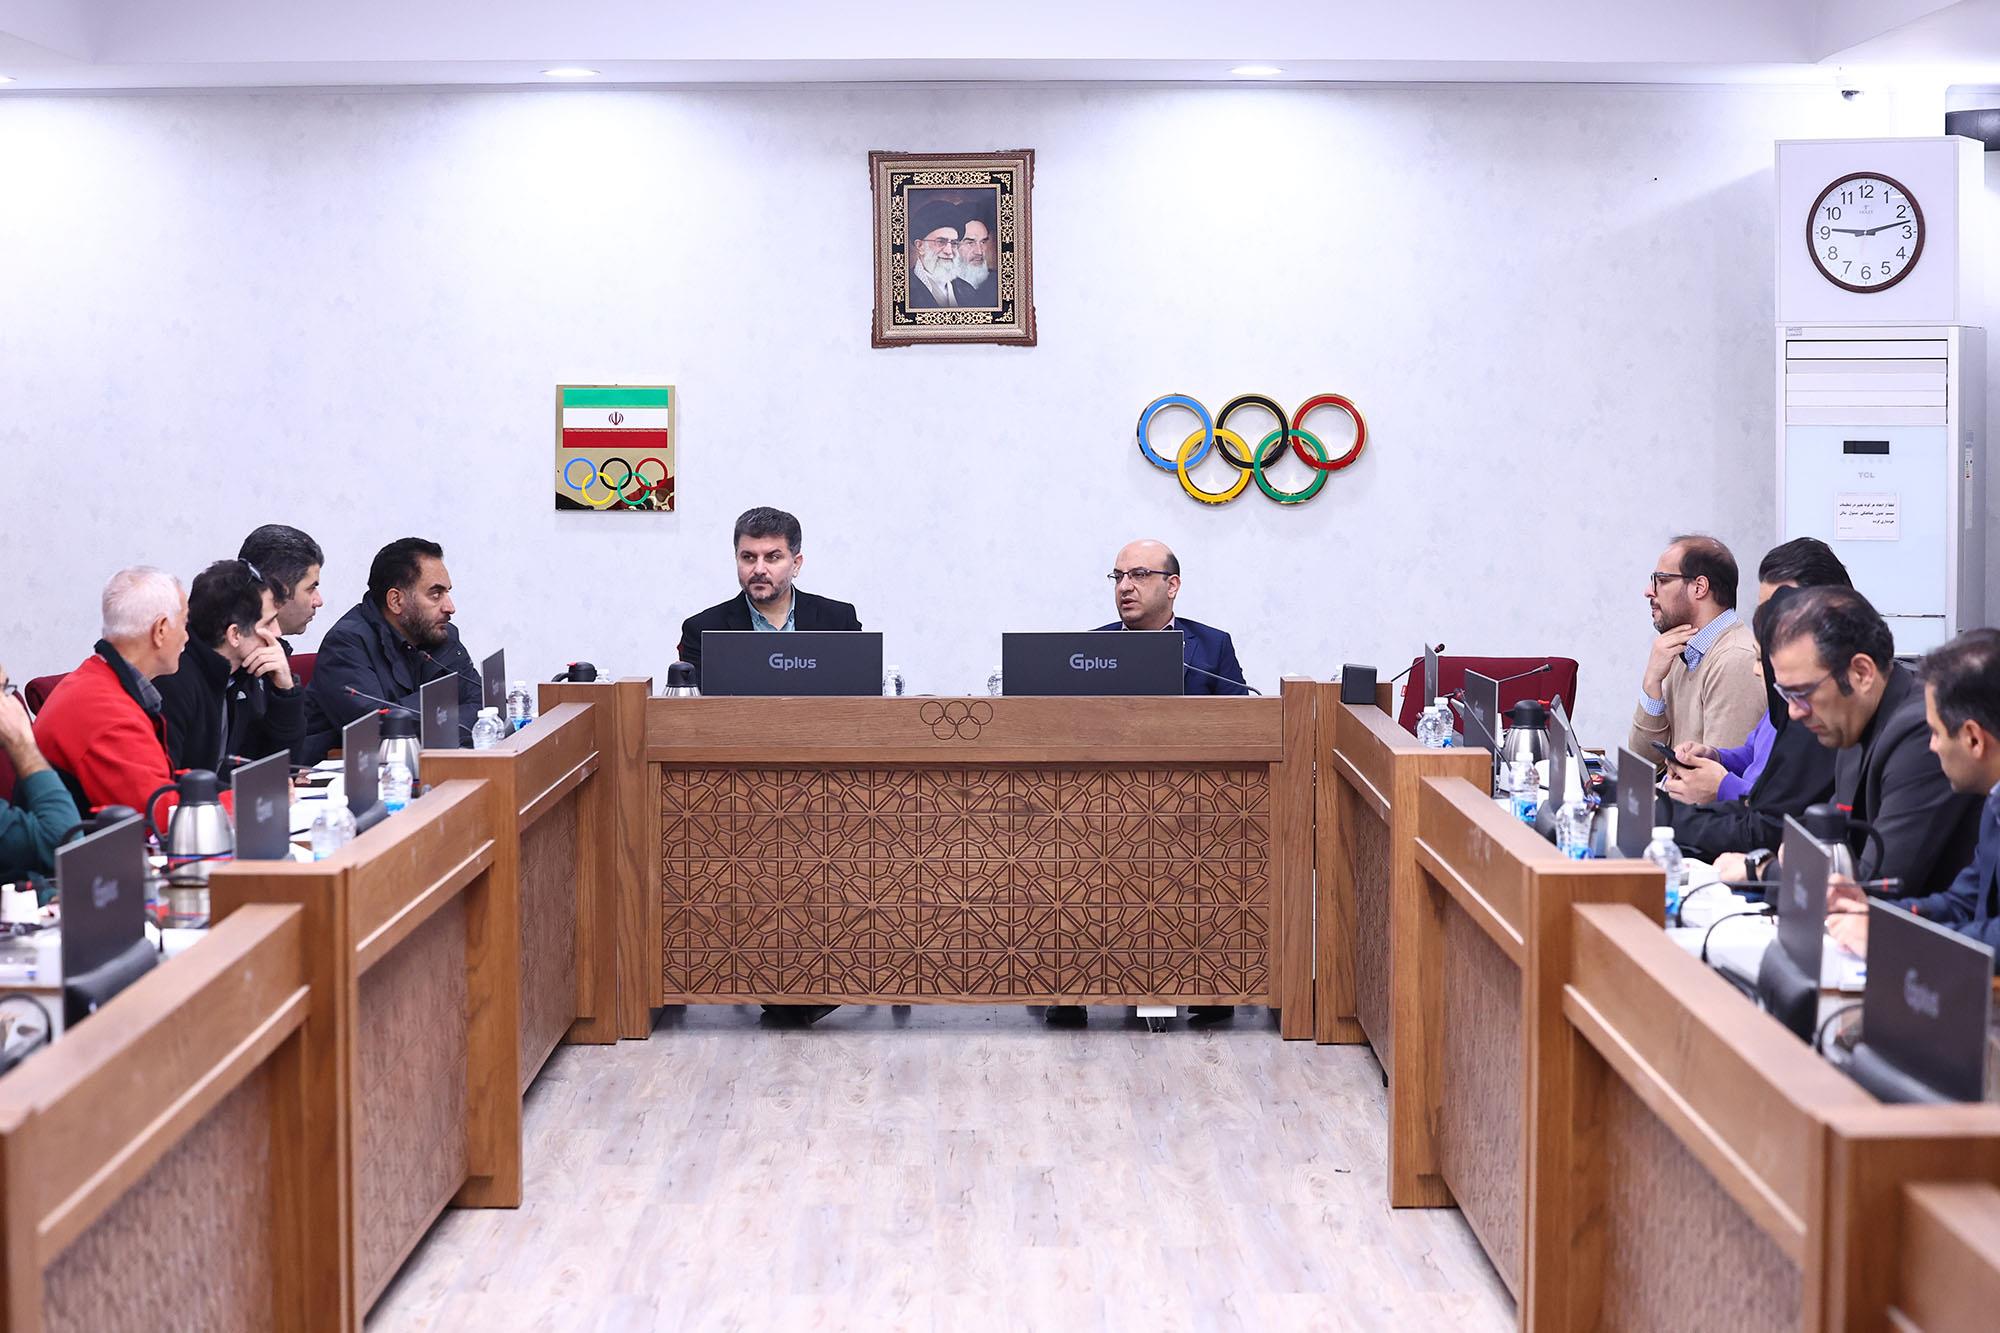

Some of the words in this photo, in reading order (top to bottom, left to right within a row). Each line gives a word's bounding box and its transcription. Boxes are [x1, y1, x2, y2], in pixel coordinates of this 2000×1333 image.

[1840, 191, 1853, 204] 11
[1859, 184, 1874, 198] 12
[1883, 191, 1889, 203] 1
[1826, 207, 1841, 220] 10
[1896, 205, 1906, 218] 2
[1820, 226, 1830, 240] 9
[1902, 226, 1912, 239] 3
[1828, 246, 1838, 260] 8
[1896, 246, 1906, 260] 4
[1843, 261, 1852, 274] 7
[1861, 266, 1871, 280] 6
[1881, 261, 1890, 274] 5
[768, 653, 816, 671] Gplus
[1069, 653, 1117, 671] Gplus
